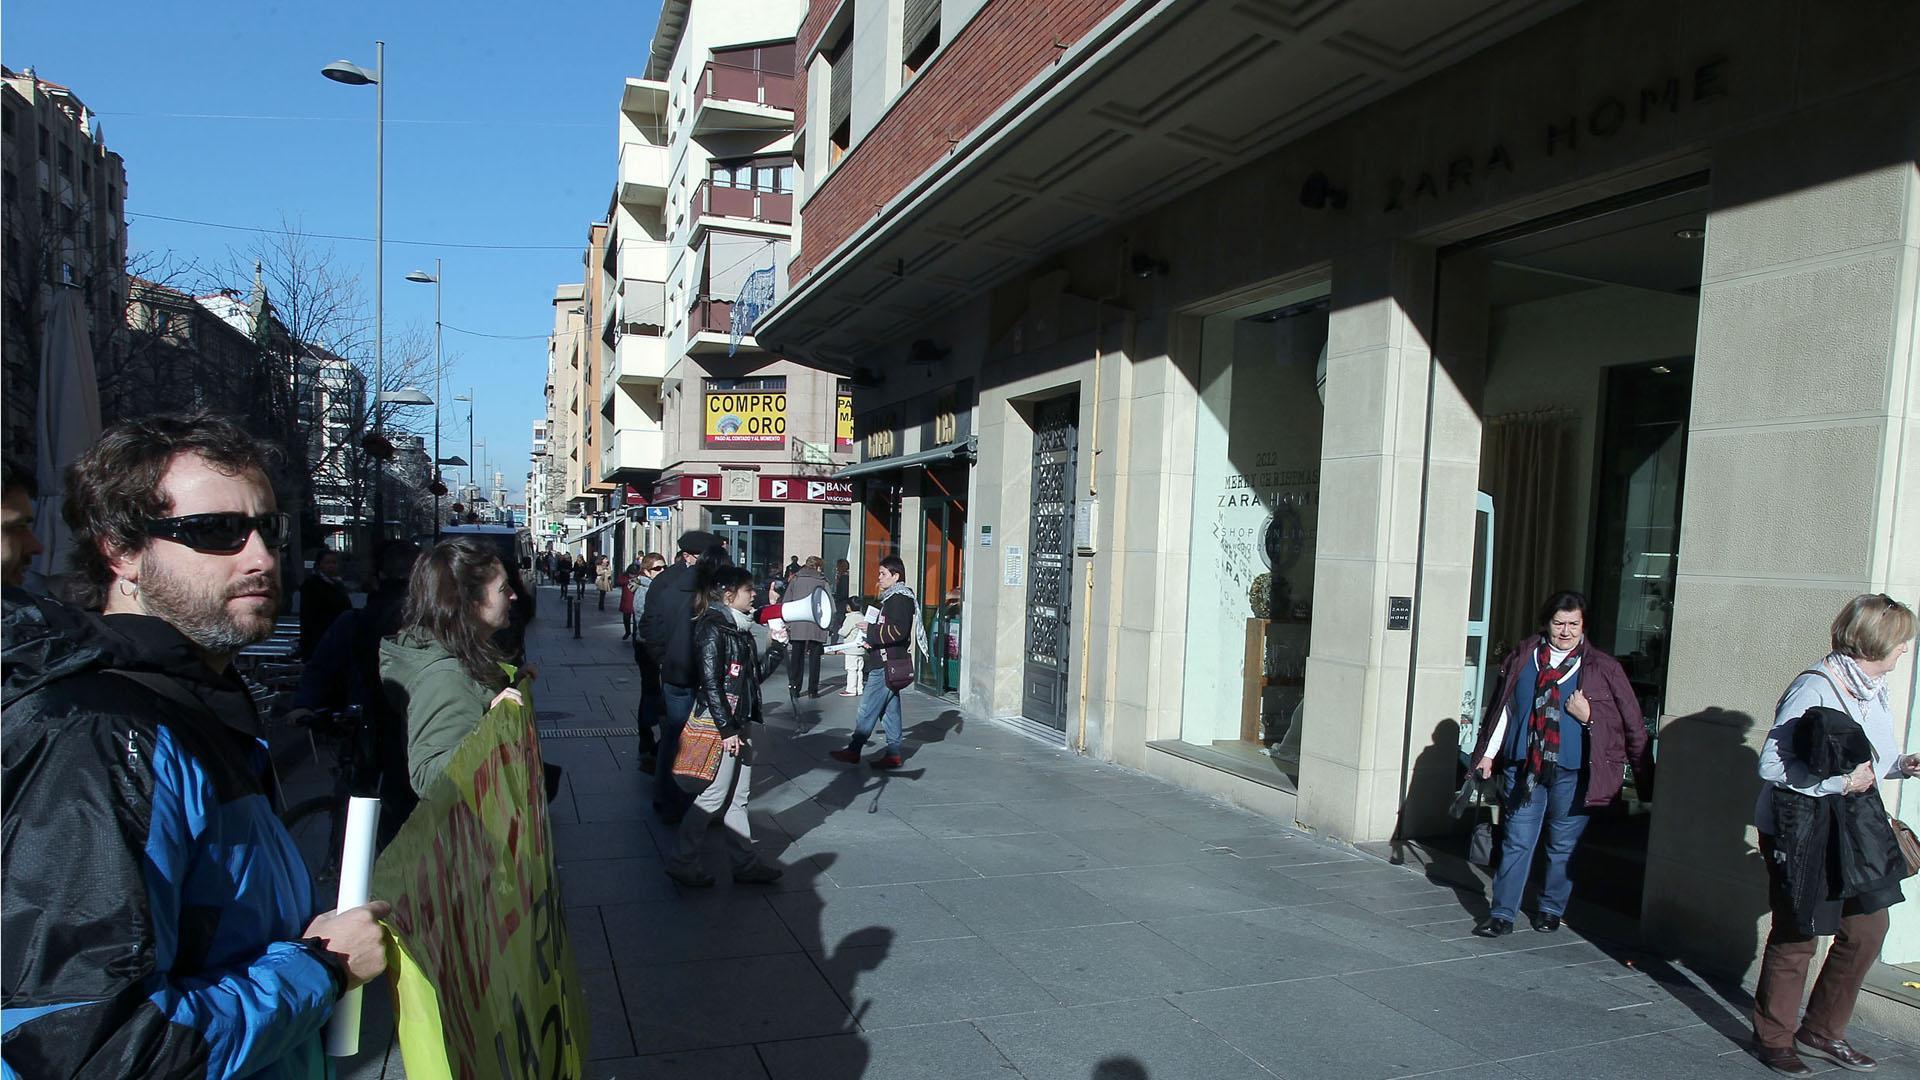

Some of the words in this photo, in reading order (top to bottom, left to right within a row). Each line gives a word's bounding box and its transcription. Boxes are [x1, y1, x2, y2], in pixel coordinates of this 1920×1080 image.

[1384, 141, 1514, 212] ZARA
[1545, 55, 1729, 157] HOME
[710, 395, 786, 413] COMPRO
[748, 416, 786, 434] ORO
[1255, 451, 1279, 467] 2012
[826, 482, 853, 493] BANC
[1224, 473, 1256, 490] MERRY
[1259, 469, 1319, 488] CHRISTMAS
[1216, 493, 1261, 508] ZARA
[1221, 527, 1254, 538] SHOP
